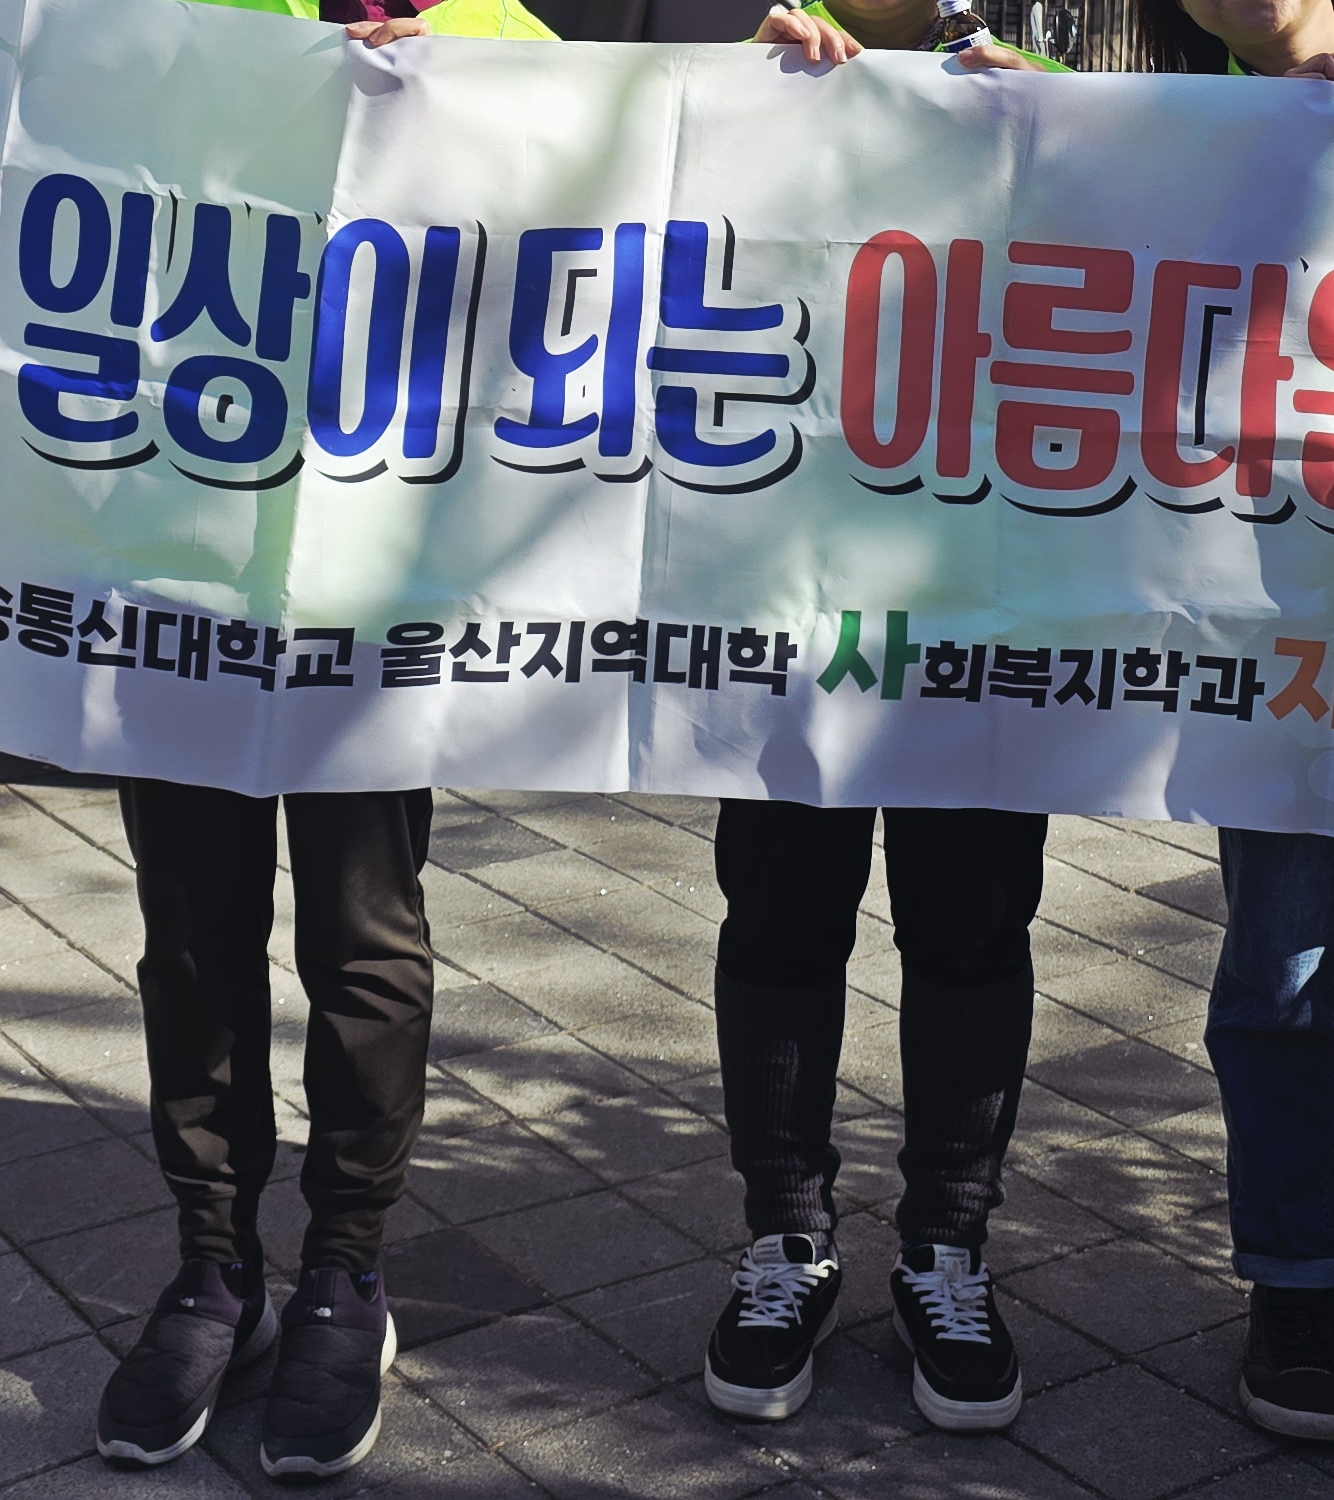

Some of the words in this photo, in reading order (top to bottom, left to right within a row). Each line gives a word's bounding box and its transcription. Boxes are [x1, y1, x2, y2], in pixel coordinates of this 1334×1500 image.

[18, 172, 463, 464] 일상이
[494, 221, 790, 469] 되는
[380, 617, 799, 697] 울산지역대학
